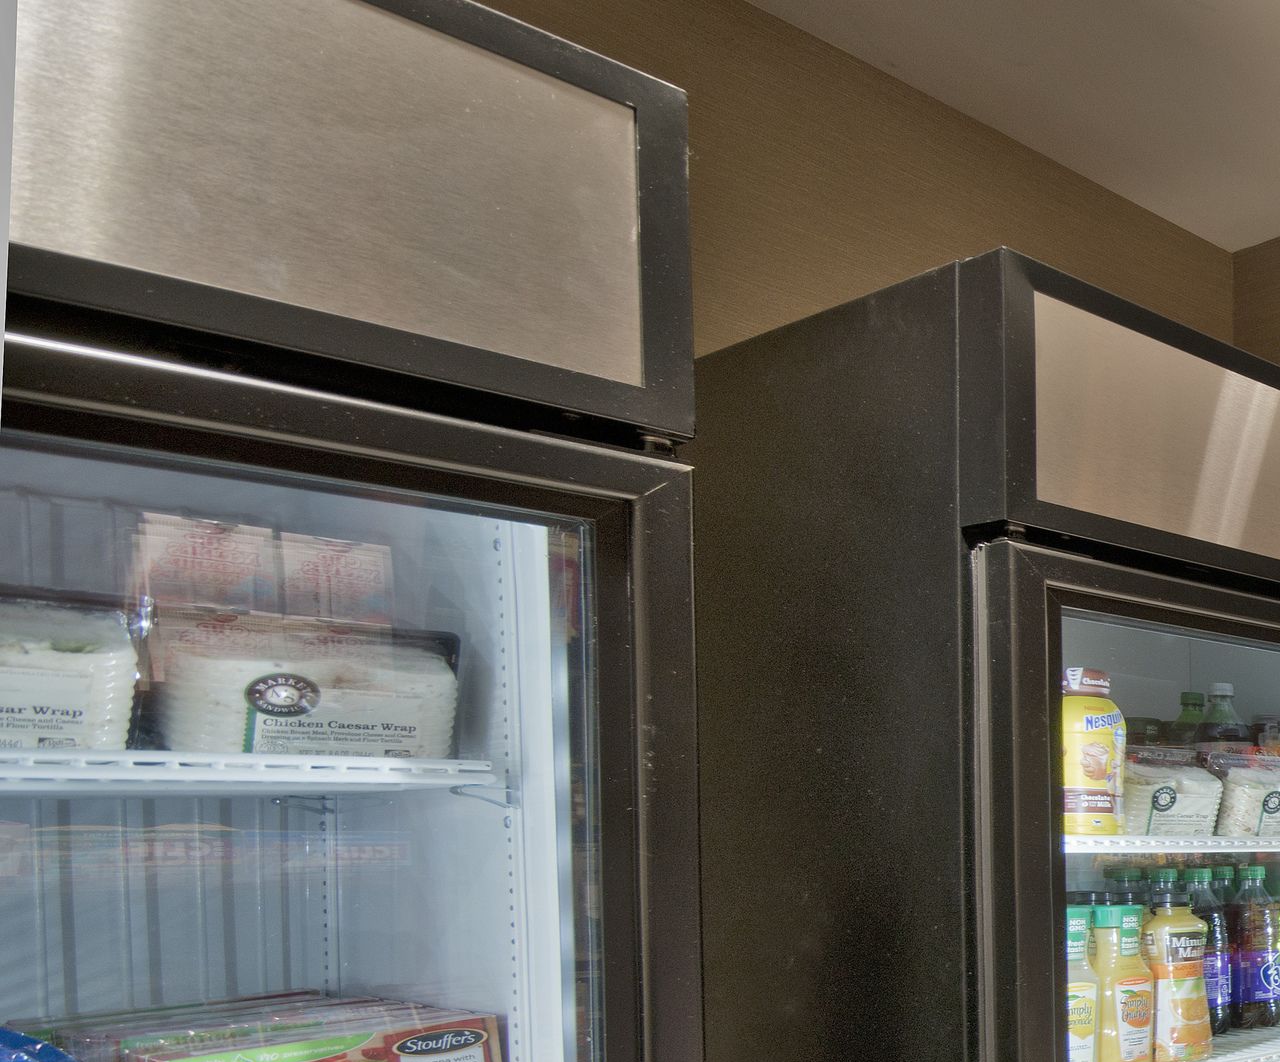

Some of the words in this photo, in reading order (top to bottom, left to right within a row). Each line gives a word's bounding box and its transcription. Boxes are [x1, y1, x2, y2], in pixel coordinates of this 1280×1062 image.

[38, 705, 83, 718] Wrap
[263, 719, 323, 728] Chicken
[328, 721, 377, 730] Caesar
[381, 723, 416, 733] Wrap
[405, 1031, 476, 1052] Stouffer's
[453, 1053, 476, 1062] with
